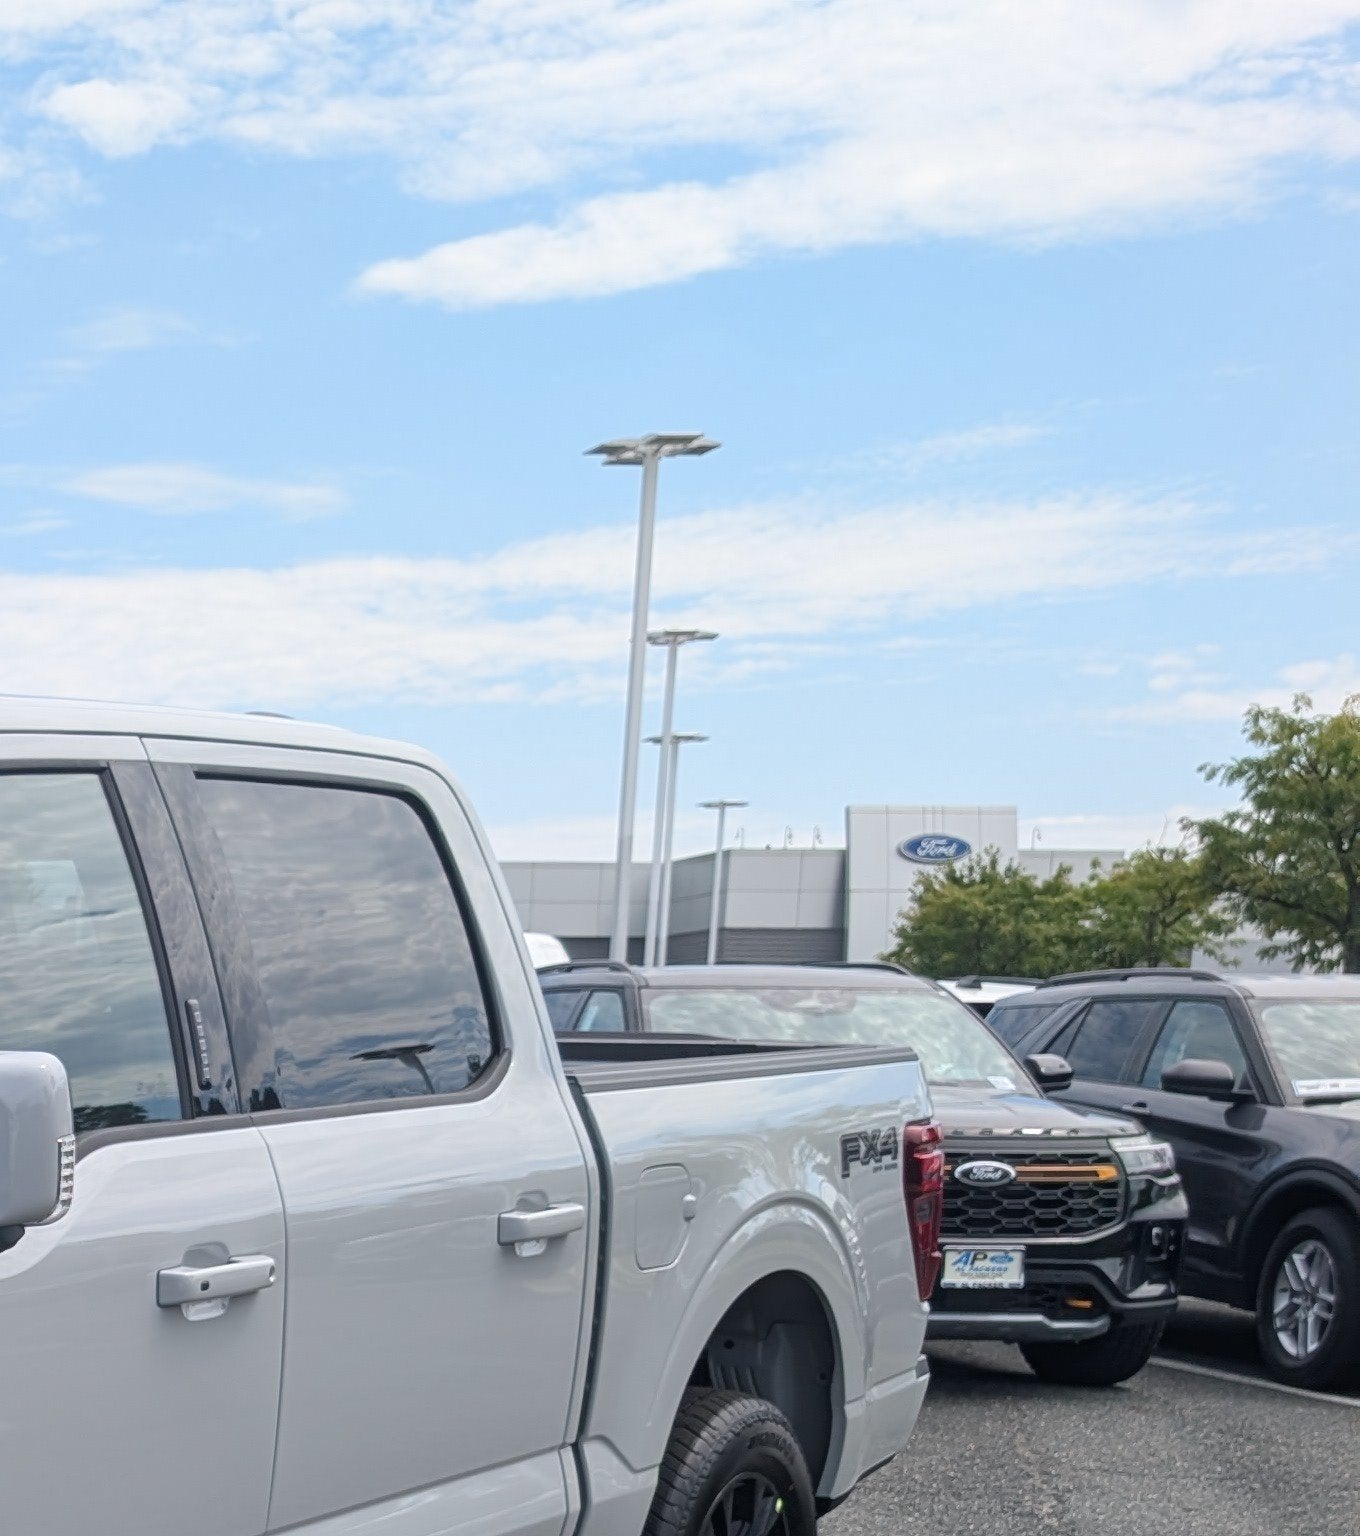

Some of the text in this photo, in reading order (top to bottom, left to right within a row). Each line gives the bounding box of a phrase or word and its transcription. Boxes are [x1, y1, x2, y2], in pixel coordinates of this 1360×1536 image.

[916, 837, 958, 857] Ford
[839, 1126, 899, 1179] FX4
[951, 1250, 988, 1266] AP
